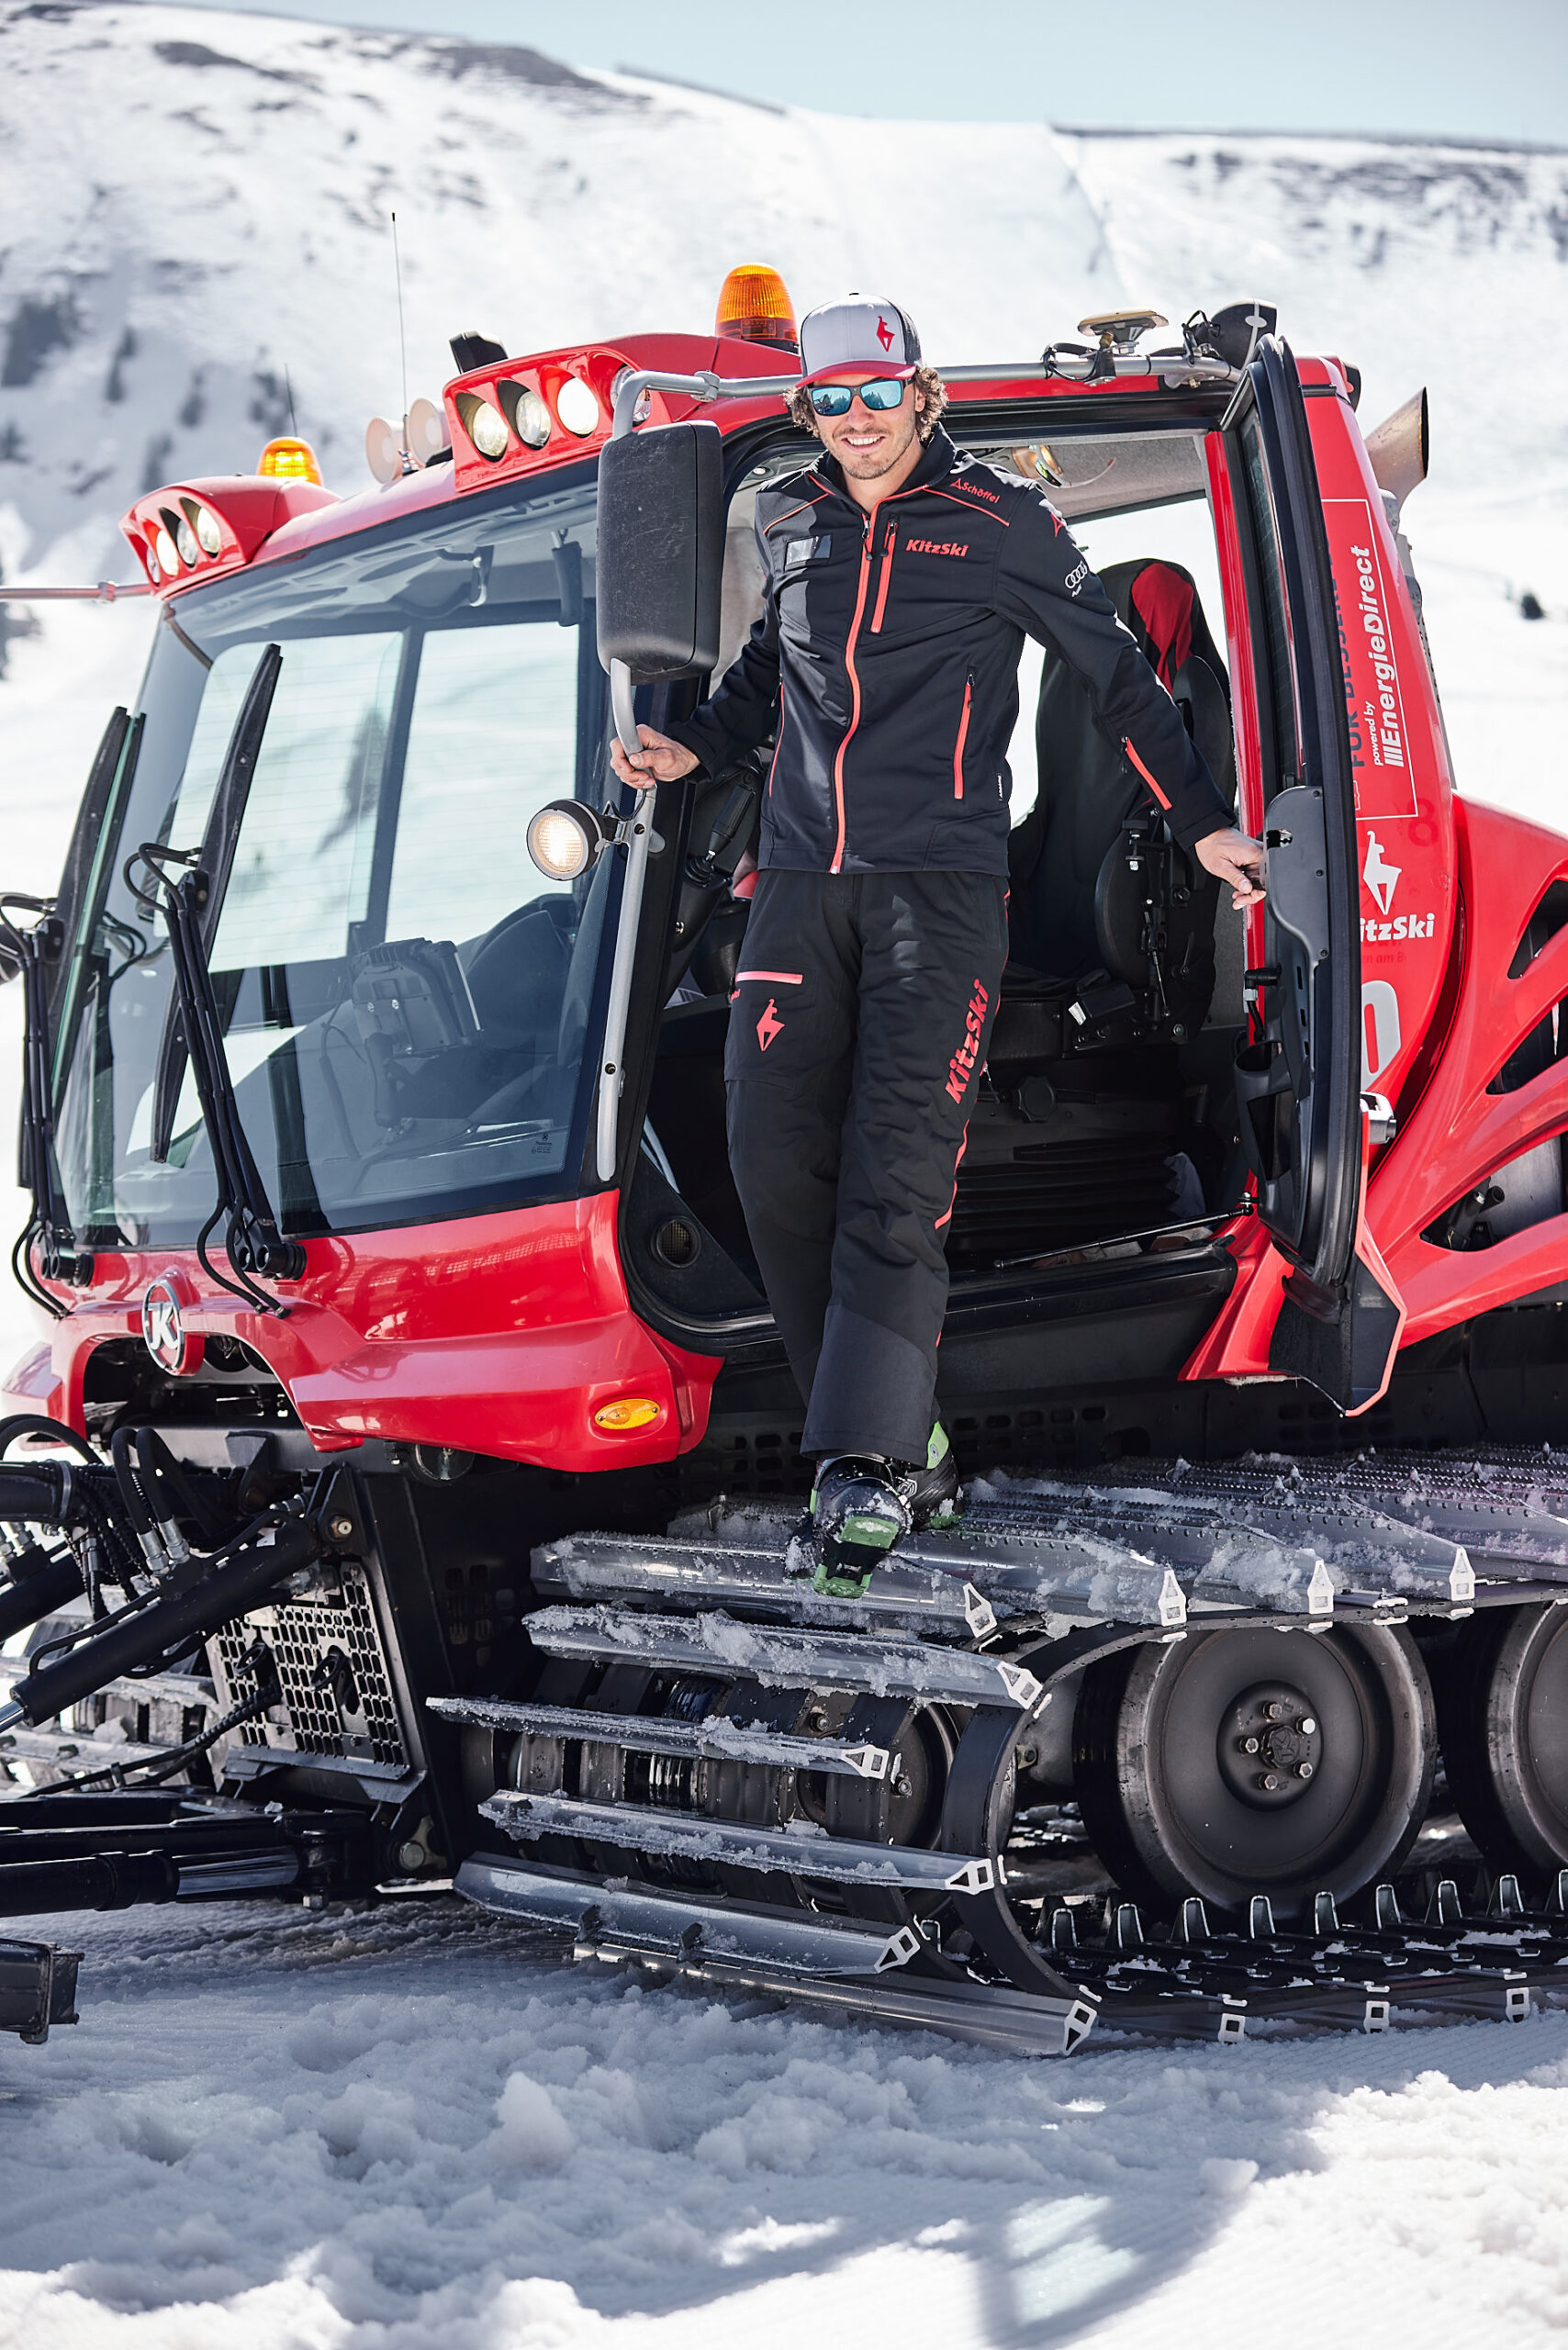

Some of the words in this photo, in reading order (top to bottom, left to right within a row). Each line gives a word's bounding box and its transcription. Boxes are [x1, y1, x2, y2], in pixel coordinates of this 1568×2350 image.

[961, 482, 1001, 504] Schöffel
[905, 539, 969, 557] KitzSki
[1350, 545, 1403, 749] EnergieDirect
[1363, 701, 1375, 716] by
[1364, 718, 1383, 767] powered
[1361, 912, 1435, 943] itzSki
[945, 979, 989, 1104] KitzSki
